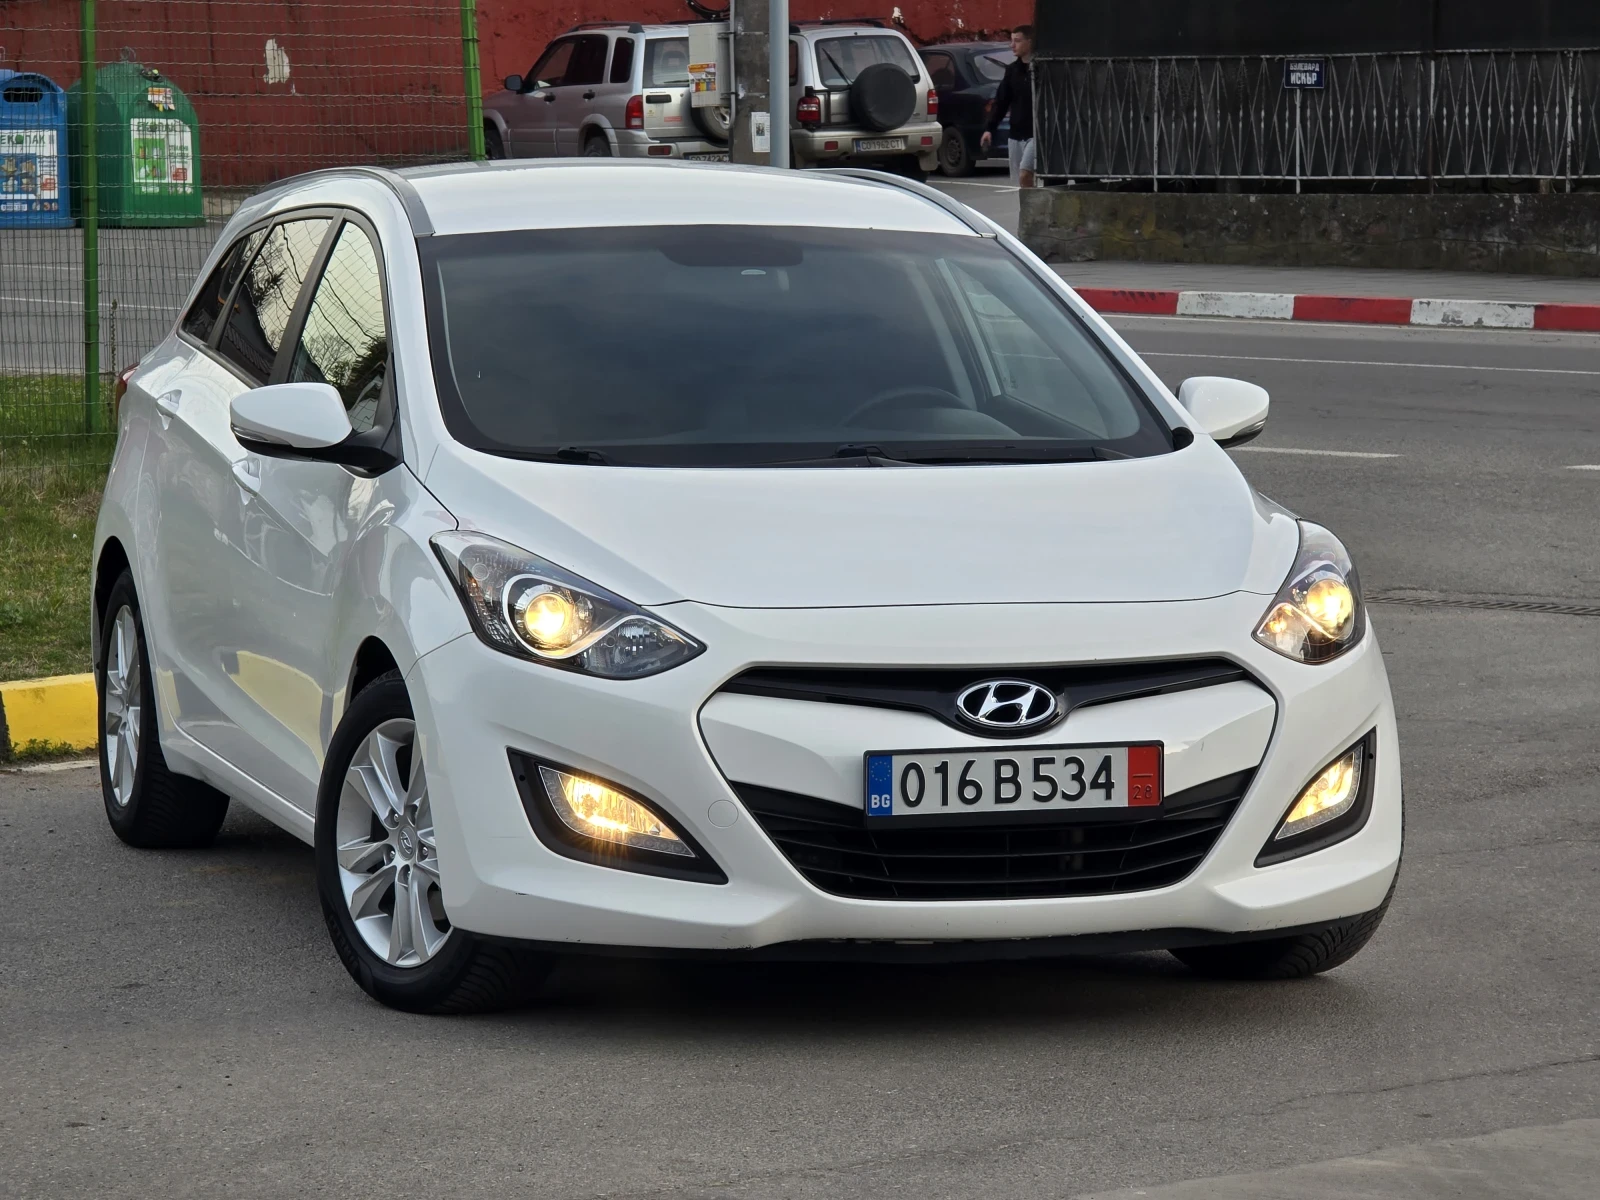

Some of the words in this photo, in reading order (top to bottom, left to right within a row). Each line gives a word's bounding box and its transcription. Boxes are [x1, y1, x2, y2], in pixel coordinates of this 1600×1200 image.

[1290, 72, 1317, 85] ИСКЪР
[1132, 784, 1153, 800] 28
[871, 794, 891, 808] BG
